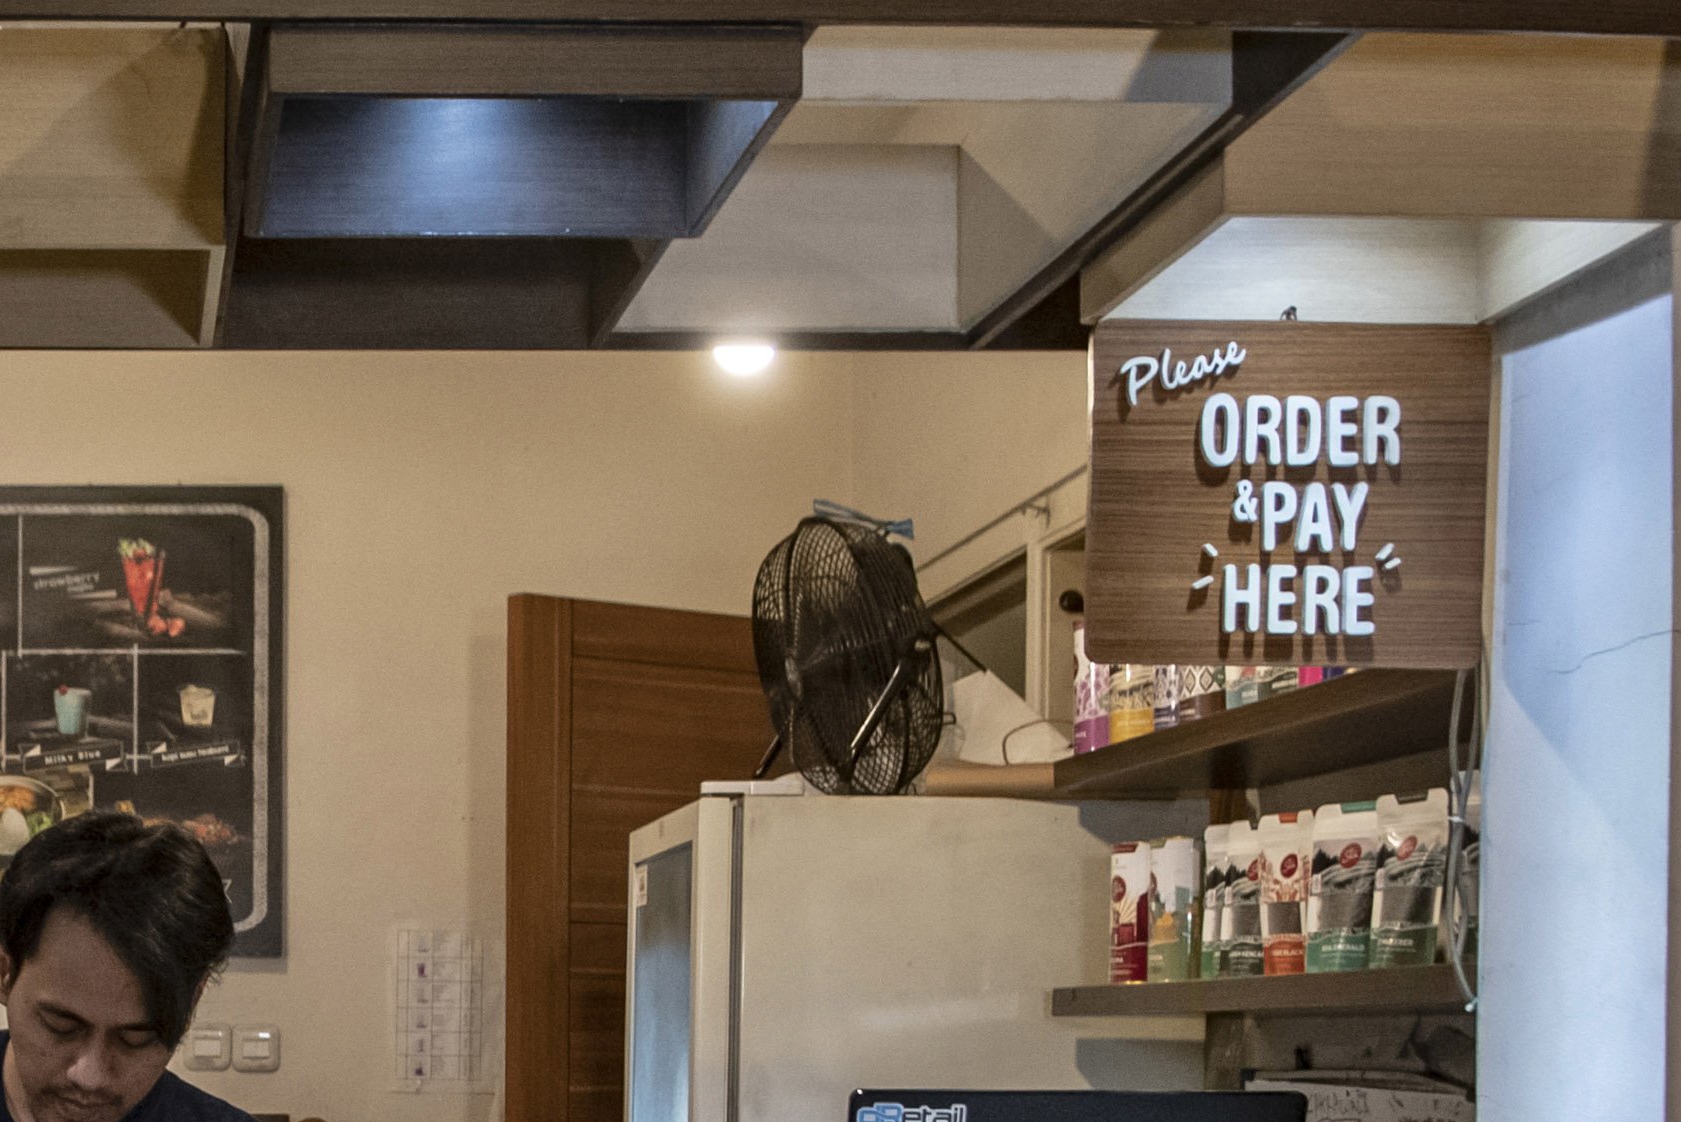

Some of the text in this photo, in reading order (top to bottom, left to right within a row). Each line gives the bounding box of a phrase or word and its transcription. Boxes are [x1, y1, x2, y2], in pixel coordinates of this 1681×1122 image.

[1120, 341, 1246, 406] Please
[1200, 393, 1401, 467] ORDER
[1222, 564, 1376, 636] HERE
